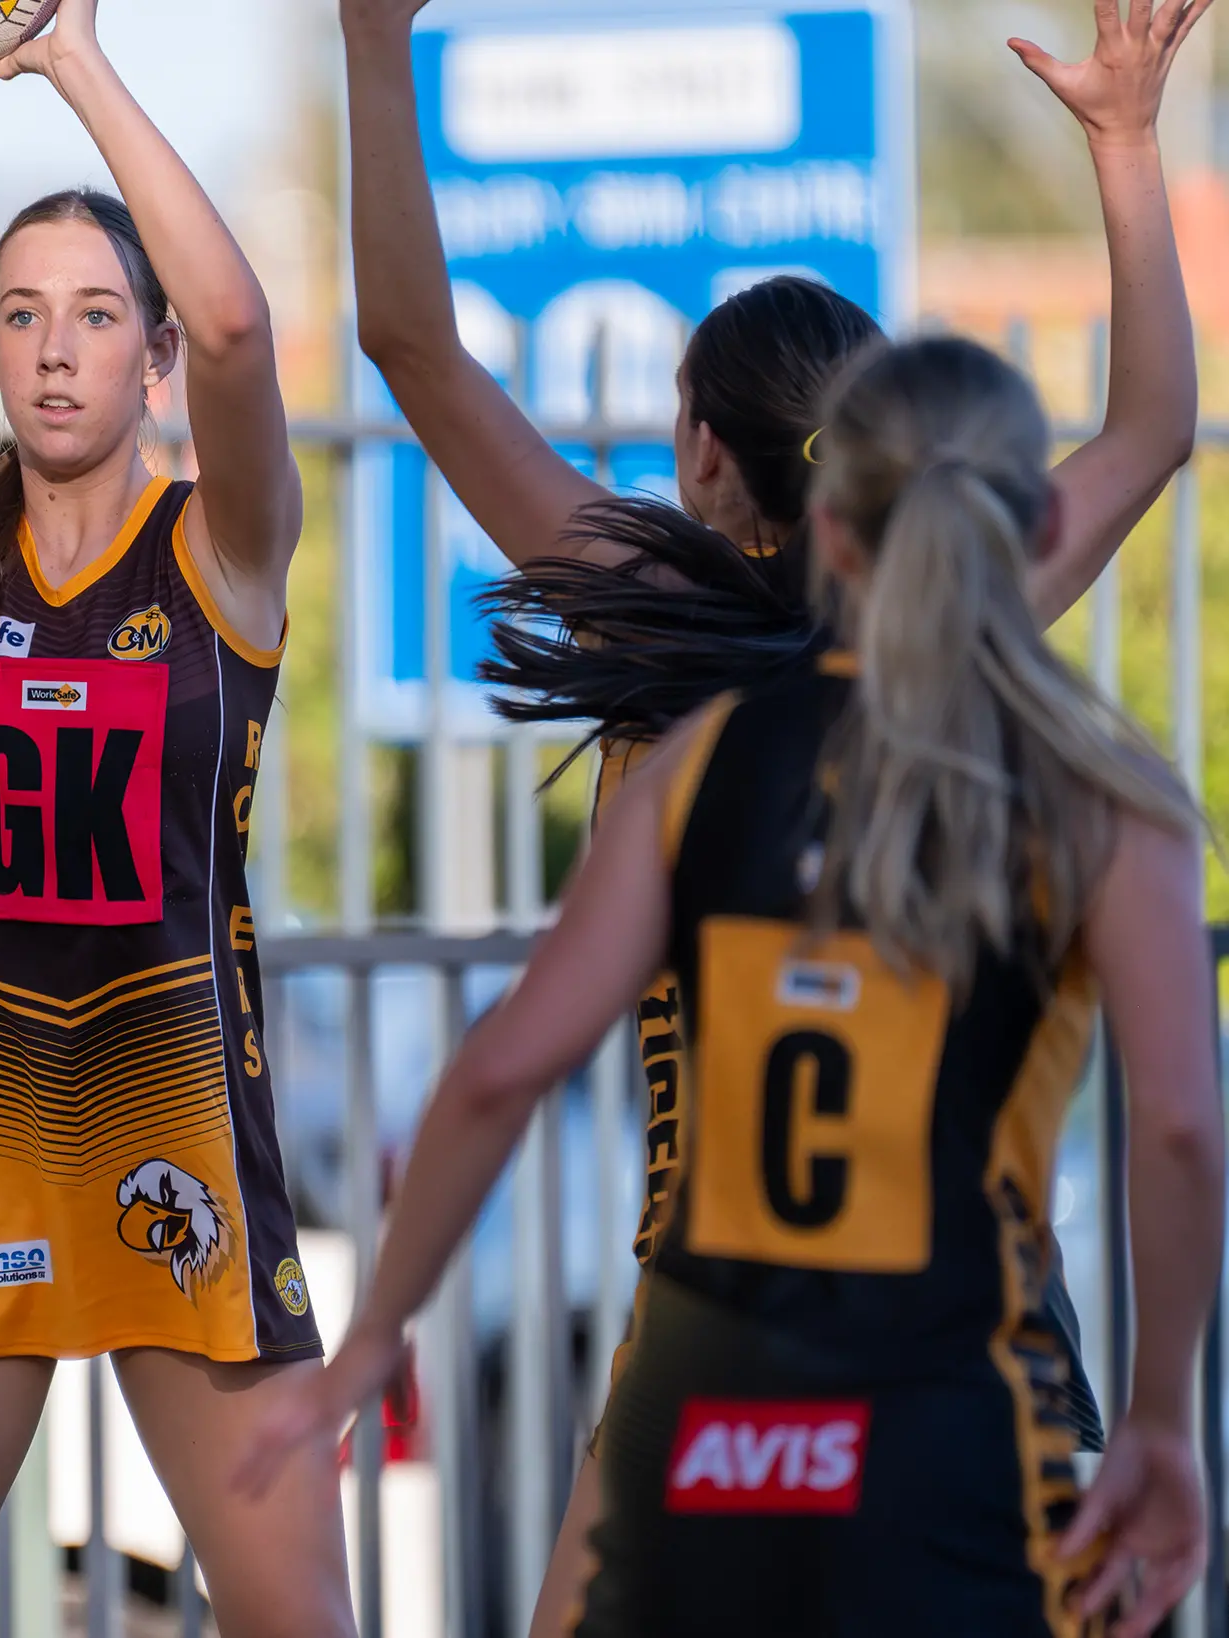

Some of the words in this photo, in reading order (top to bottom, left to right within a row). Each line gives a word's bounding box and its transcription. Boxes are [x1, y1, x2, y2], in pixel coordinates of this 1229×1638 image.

[111, 623, 163, 651] O&M
[31, 688, 77, 700] WorkSafe
[230, 719, 262, 1078] ROERS
[761, 1029, 853, 1228] C
[274, 1266, 303, 1292] ROVER
[674, 1420, 860, 1492] AVIS
